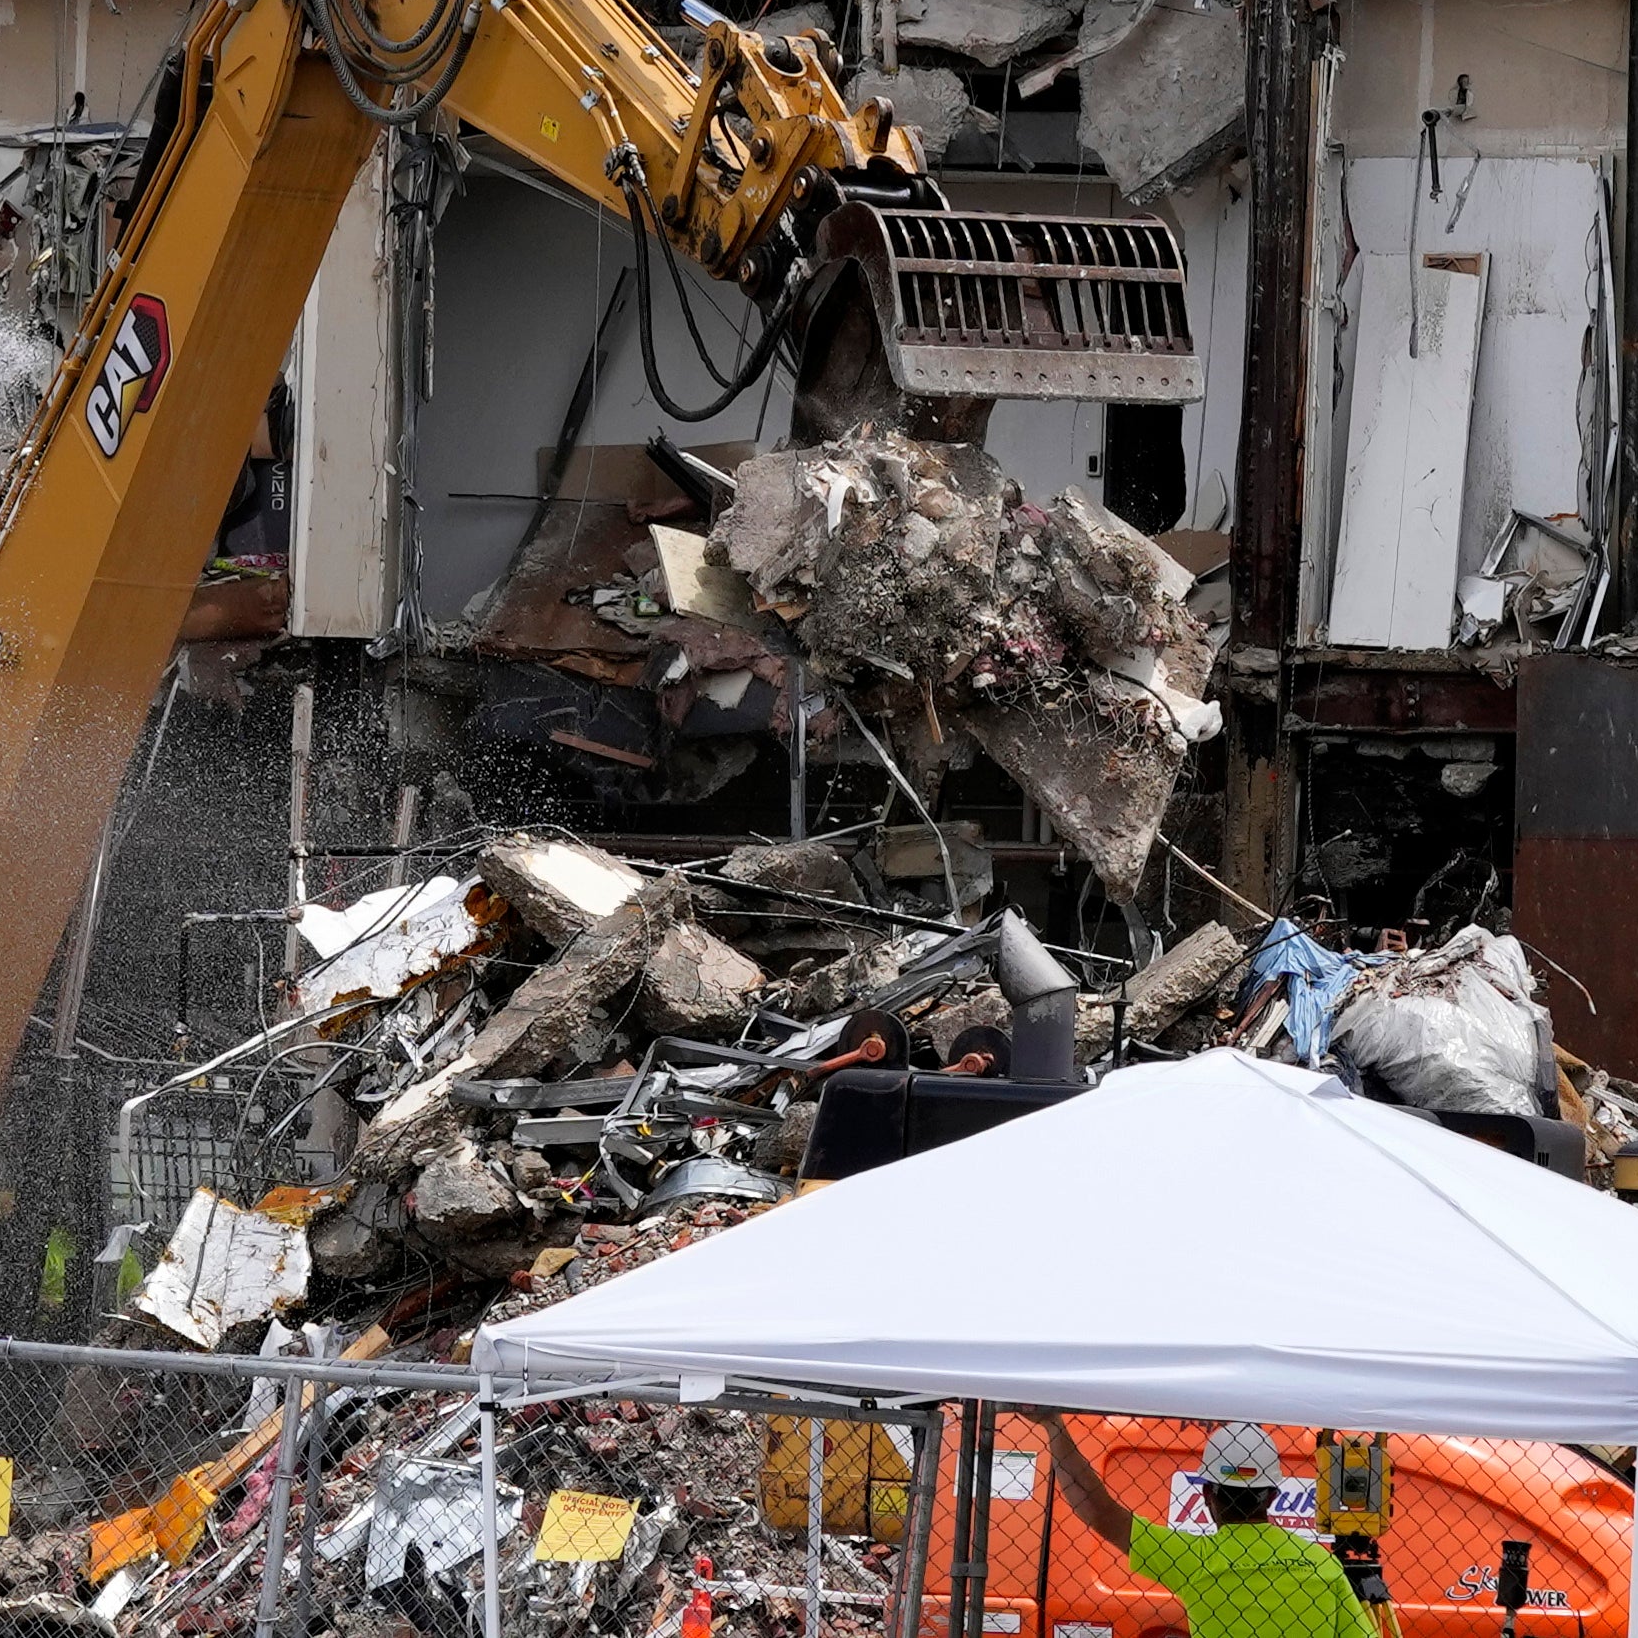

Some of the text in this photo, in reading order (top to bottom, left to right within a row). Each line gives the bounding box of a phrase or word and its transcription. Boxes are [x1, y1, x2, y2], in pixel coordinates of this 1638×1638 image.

[86, 308, 153, 457] CAT
[271, 462, 285, 511] VIZIO
[560, 1495, 600, 1508] OFFICIAL
[563, 1504, 576, 1513] DO
[578, 1506, 596, 1515] NOT
